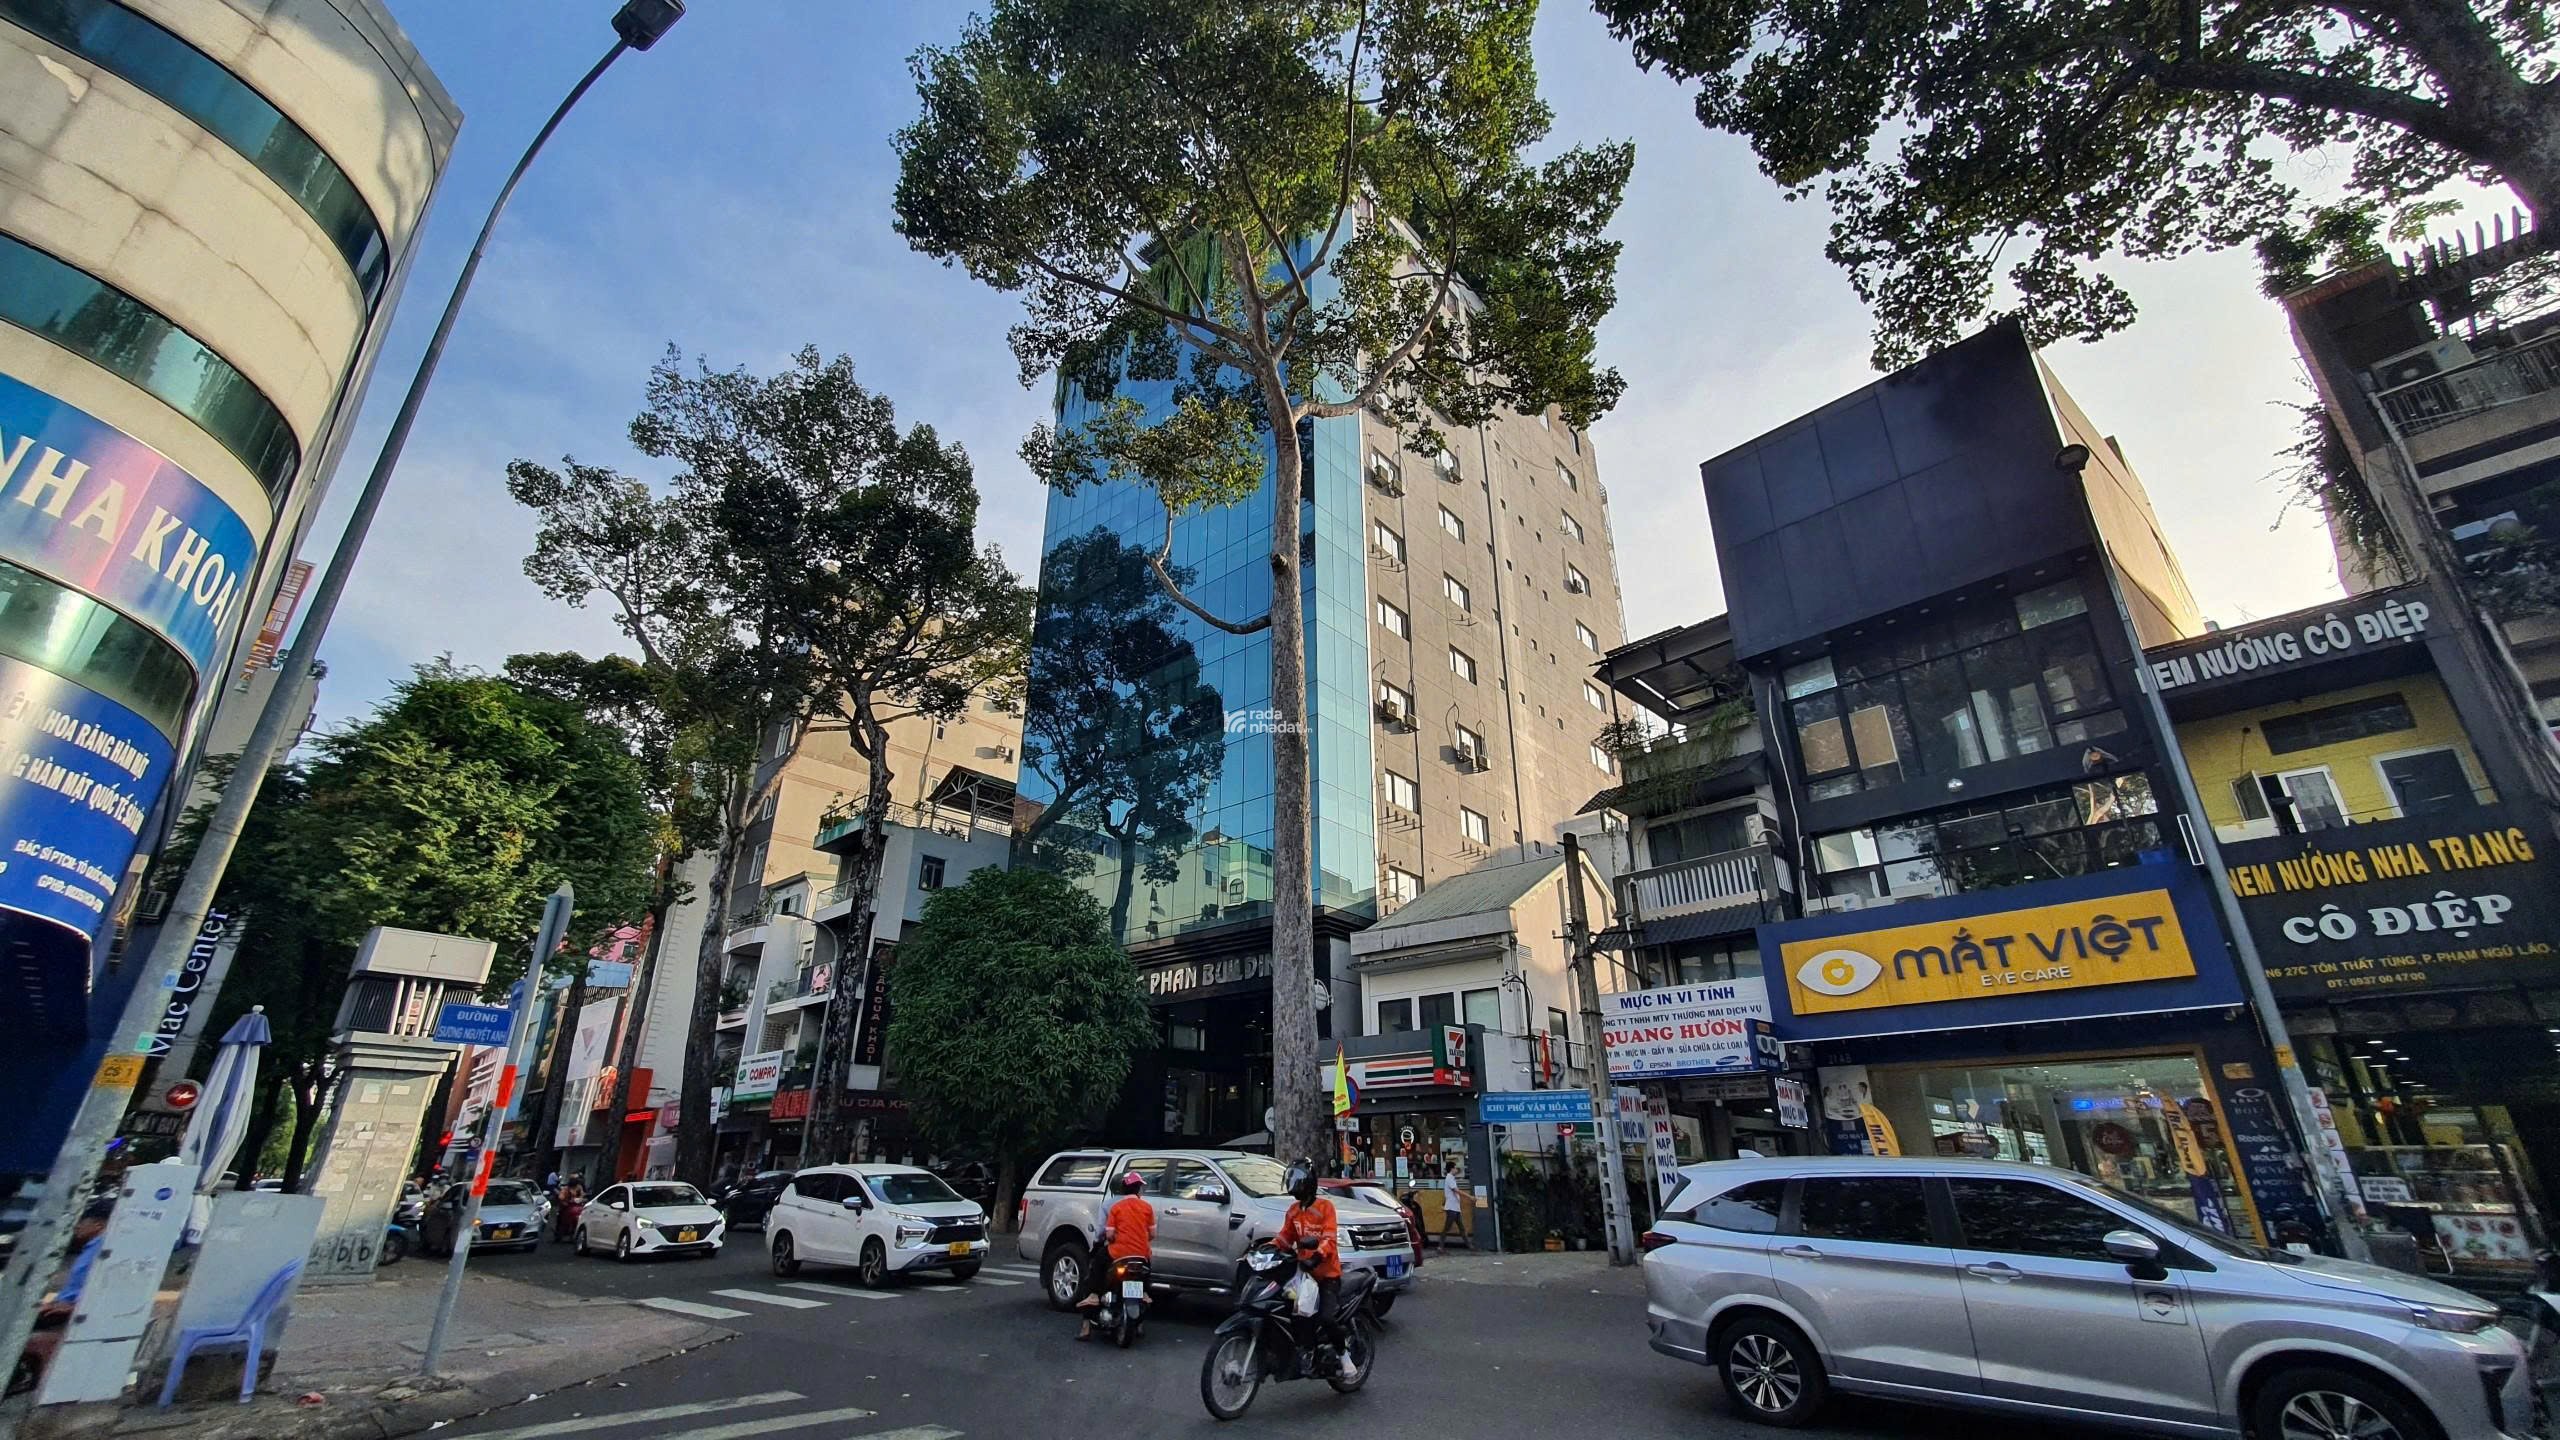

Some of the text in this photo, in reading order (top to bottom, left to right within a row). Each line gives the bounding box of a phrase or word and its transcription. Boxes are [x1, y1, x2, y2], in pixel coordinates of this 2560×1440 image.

[0, 428, 236, 626] NHA KHOA
[2196, 629, 2302, 681] NƯỚNG
[2304, 613, 2352, 655] CÔ
[2355, 599, 2430, 643] ĐIỆP
[74, 723, 116, 758] RĂNG
[25, 756, 67, 791] HÀM
[60, 771, 94, 803] MẶT
[89, 783, 120, 815] QUỐC
[14, 839, 40, 856] BÁC
[2277, 841, 2367, 892] NƯỚNG
[2368, 843, 2430, 879] NHA
[2429, 827, 2535, 871] TRANG
[2283, 890, 2513, 944] CÔ ĐIỆP
[2310, 961, 2338, 973] TÔN
[2340, 957, 2374, 971] THẤT
[2437, 949, 2480, 964] PHẠM
[2481, 944, 2514, 958] NGŨ
[150, 1001, 189, 1058] Mac
[175, 907, 229, 993] Center
[1151, 967, 1197, 995] PHAN
[1202, 953, 1274, 986] BUILDIN
[1981, 966, 2072, 987] EYE CARE
[2350, 976, 2376, 986] 0937
[1620, 985, 1735, 1010] MỰC IN VI TÍNH
[457, 1010, 499, 1022] ĐƯỜNG
[1617, 1018, 1627, 1026] TY
[1630, 1015, 1651, 1024] TNHH
[1653, 1012, 1670, 1023] MTV
[1672, 1009, 1706, 1021] THƯƠNG
[1726, 1005, 1747, 1017] DỊCH
[1750, 1004, 1762, 1014] VỤ
[1603, 1018, 1748, 1048] QUANG HƯƠN
[749, 1065, 777, 1081] COMPRO
[1650, 1061, 1671, 1069] EPSON
[1677, 1059, 1711, 1067] BROTHER
[1655, 1121, 1669, 1133] IN
[1656, 1137, 1672, 1150] NẠP
[1658, 1155, 1675, 1168] MỰC
[1662, 1172, 1676, 1184] IN
